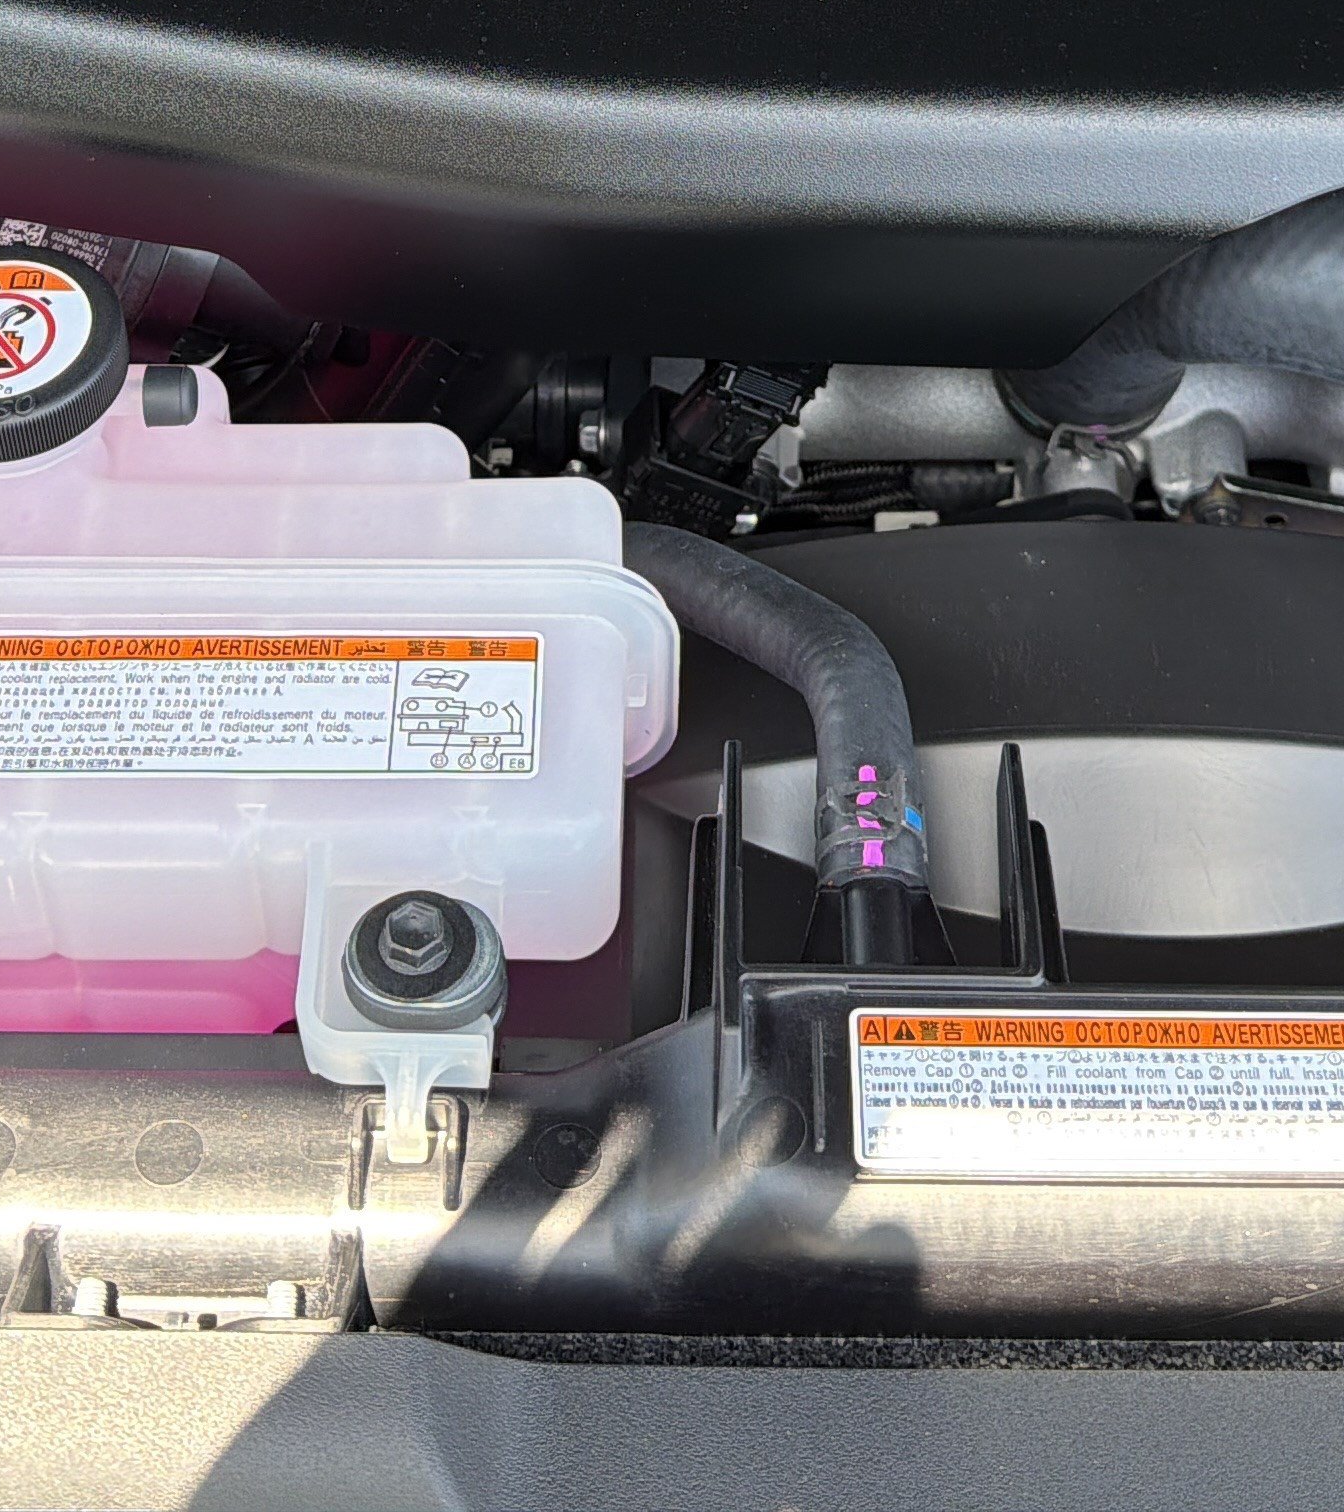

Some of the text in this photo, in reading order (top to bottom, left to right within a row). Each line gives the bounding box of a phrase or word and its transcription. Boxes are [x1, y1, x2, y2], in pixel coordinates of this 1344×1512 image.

[192, 639, 344, 656] AVERTISSEMENT
[221, 674, 258, 686] engine
[863, 1019, 882, 1041] A
[975, 1021, 1065, 1043] WARNING
[863, 1064, 917, 1077] Remove
[924, 1064, 953, 1079] Cap
[980, 1065, 1007, 1077] and
[1046, 1065, 1067, 1078] Fill
[1075, 1065, 1127, 1079] coolant
[1136, 1066, 1166, 1079] from
[1175, 1066, 1203, 1081] Cap
[1230, 1066, 1260, 1079] until
[1302, 1067, 1344, 1081] Install
